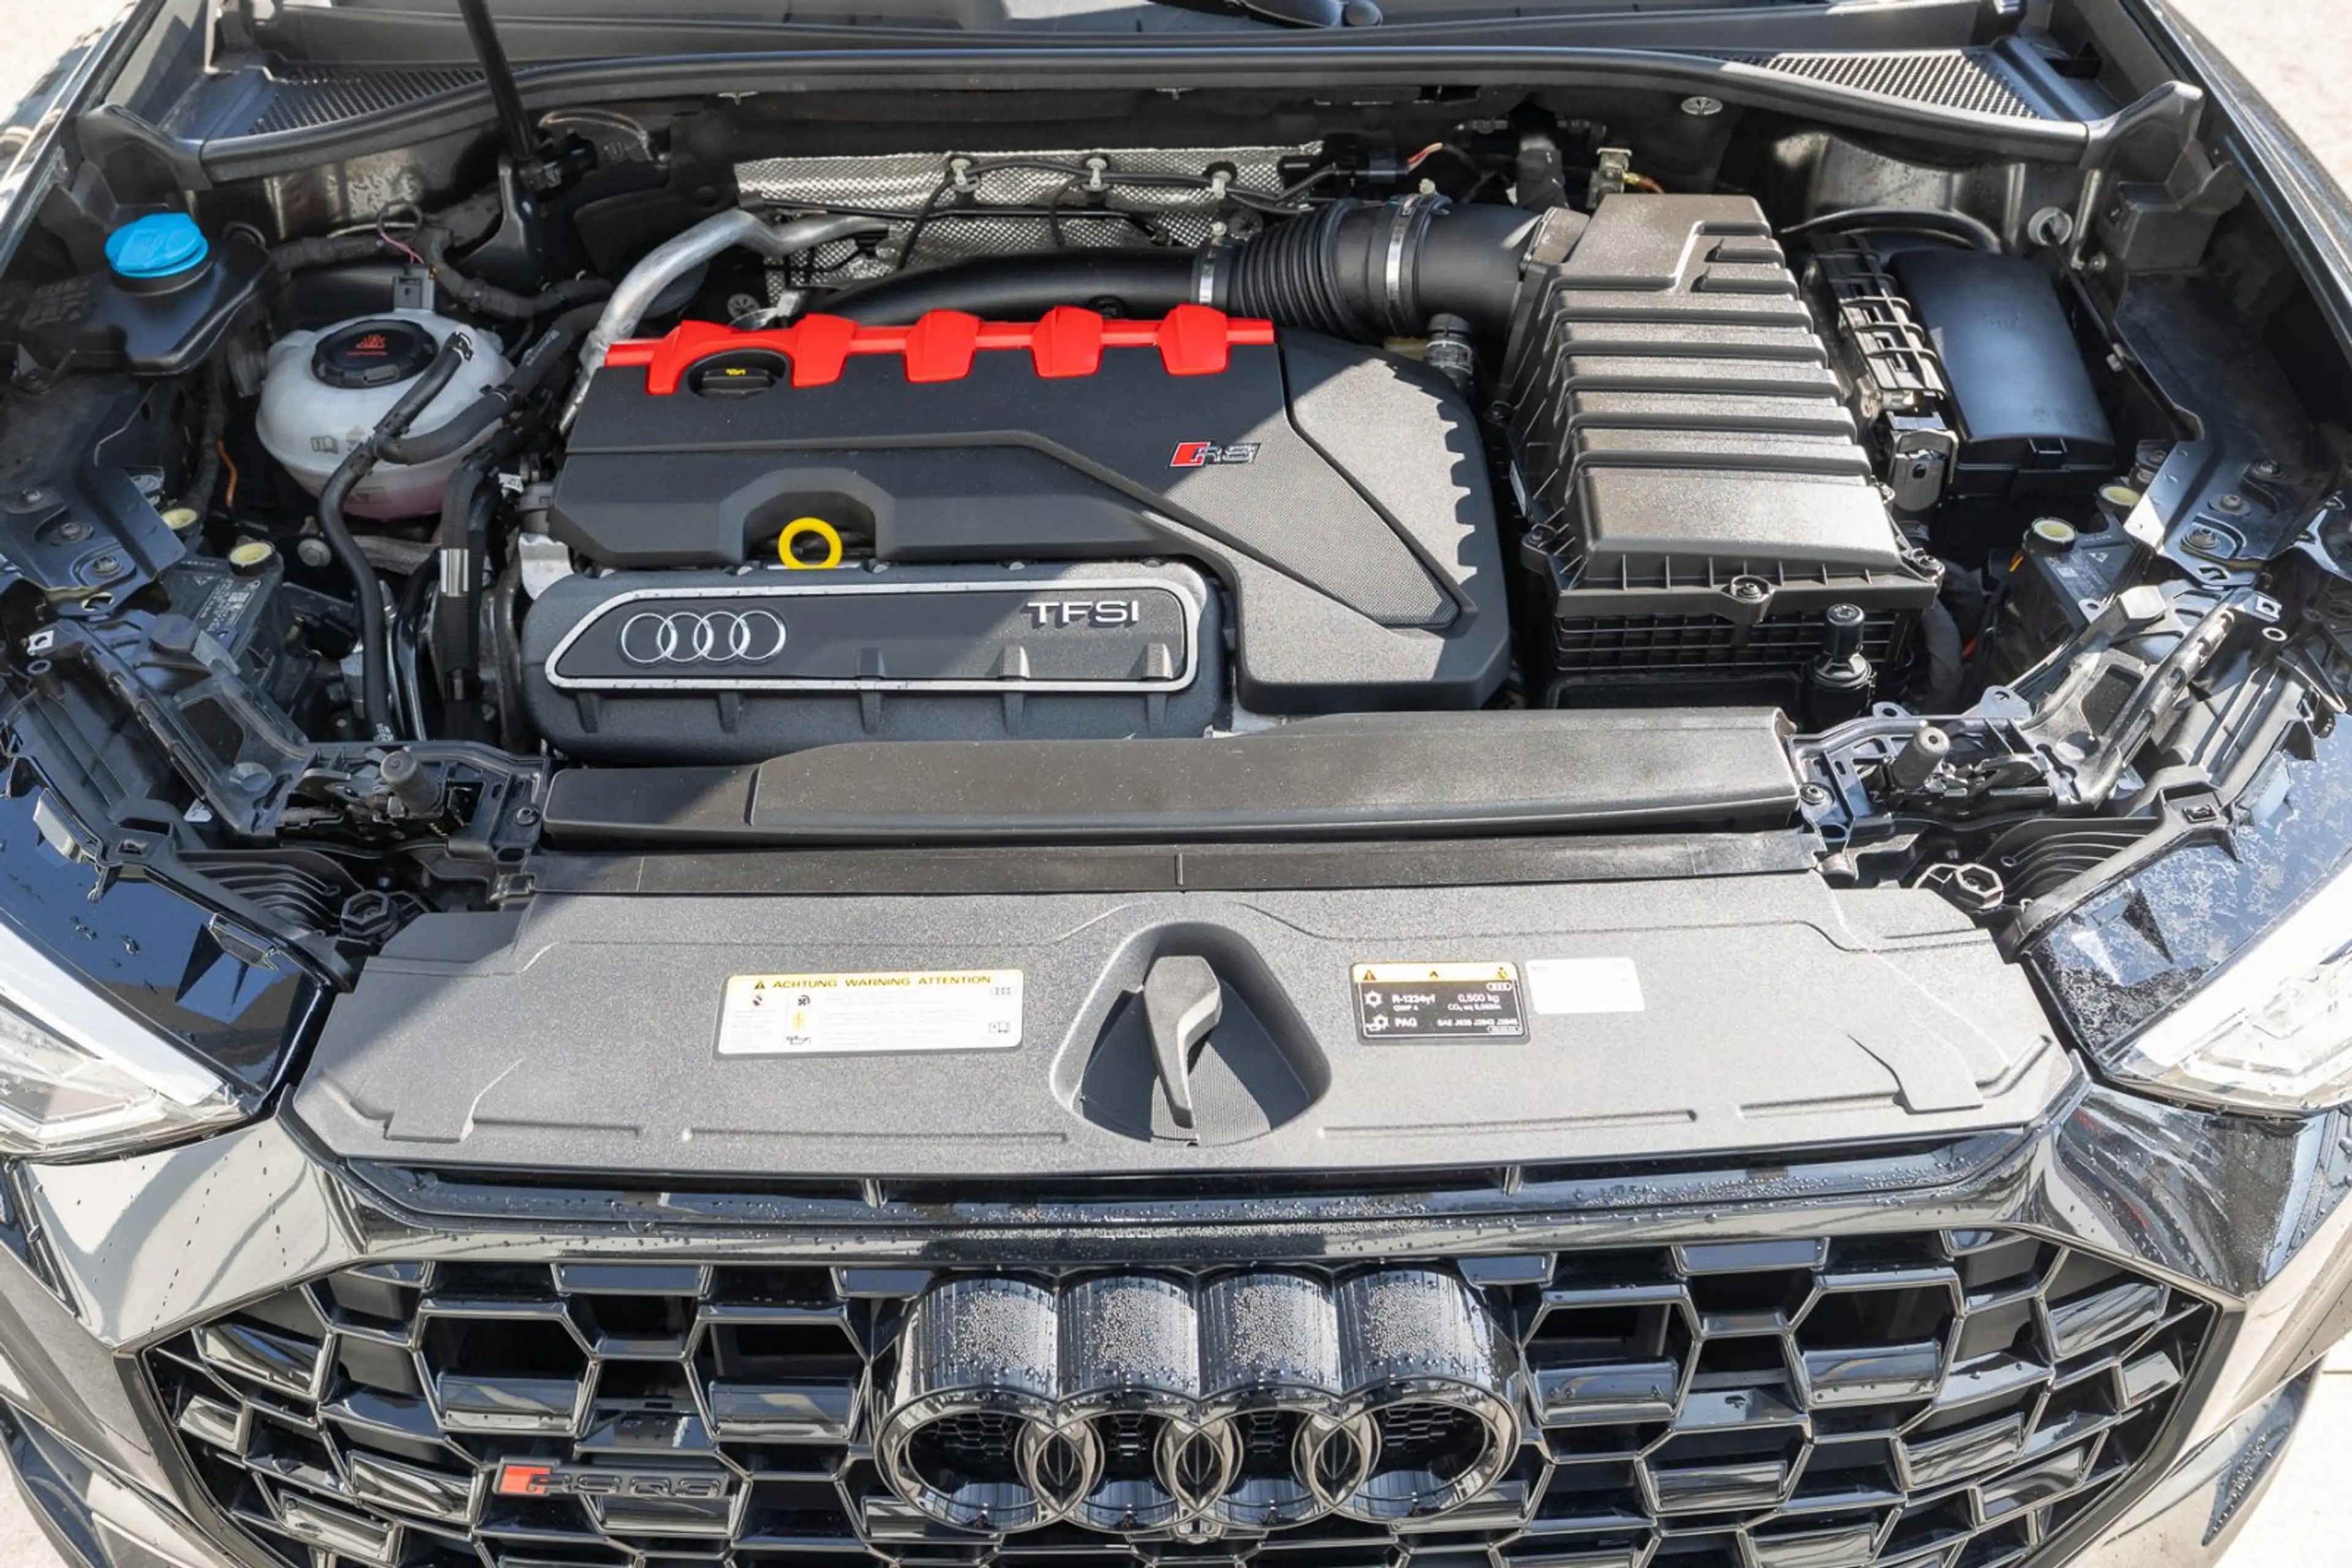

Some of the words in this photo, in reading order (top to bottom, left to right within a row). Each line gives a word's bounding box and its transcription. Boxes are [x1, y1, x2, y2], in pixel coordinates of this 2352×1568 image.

[1188, 444, 1257, 464] RS
[1027, 600, 1140, 624] TFSI
[772, 979, 839, 989] ACHTUNG
[845, 977, 911, 987] WARNING
[918, 974, 992, 986] ATTENTION
[1394, 1017, 1418, 1027] PAG
